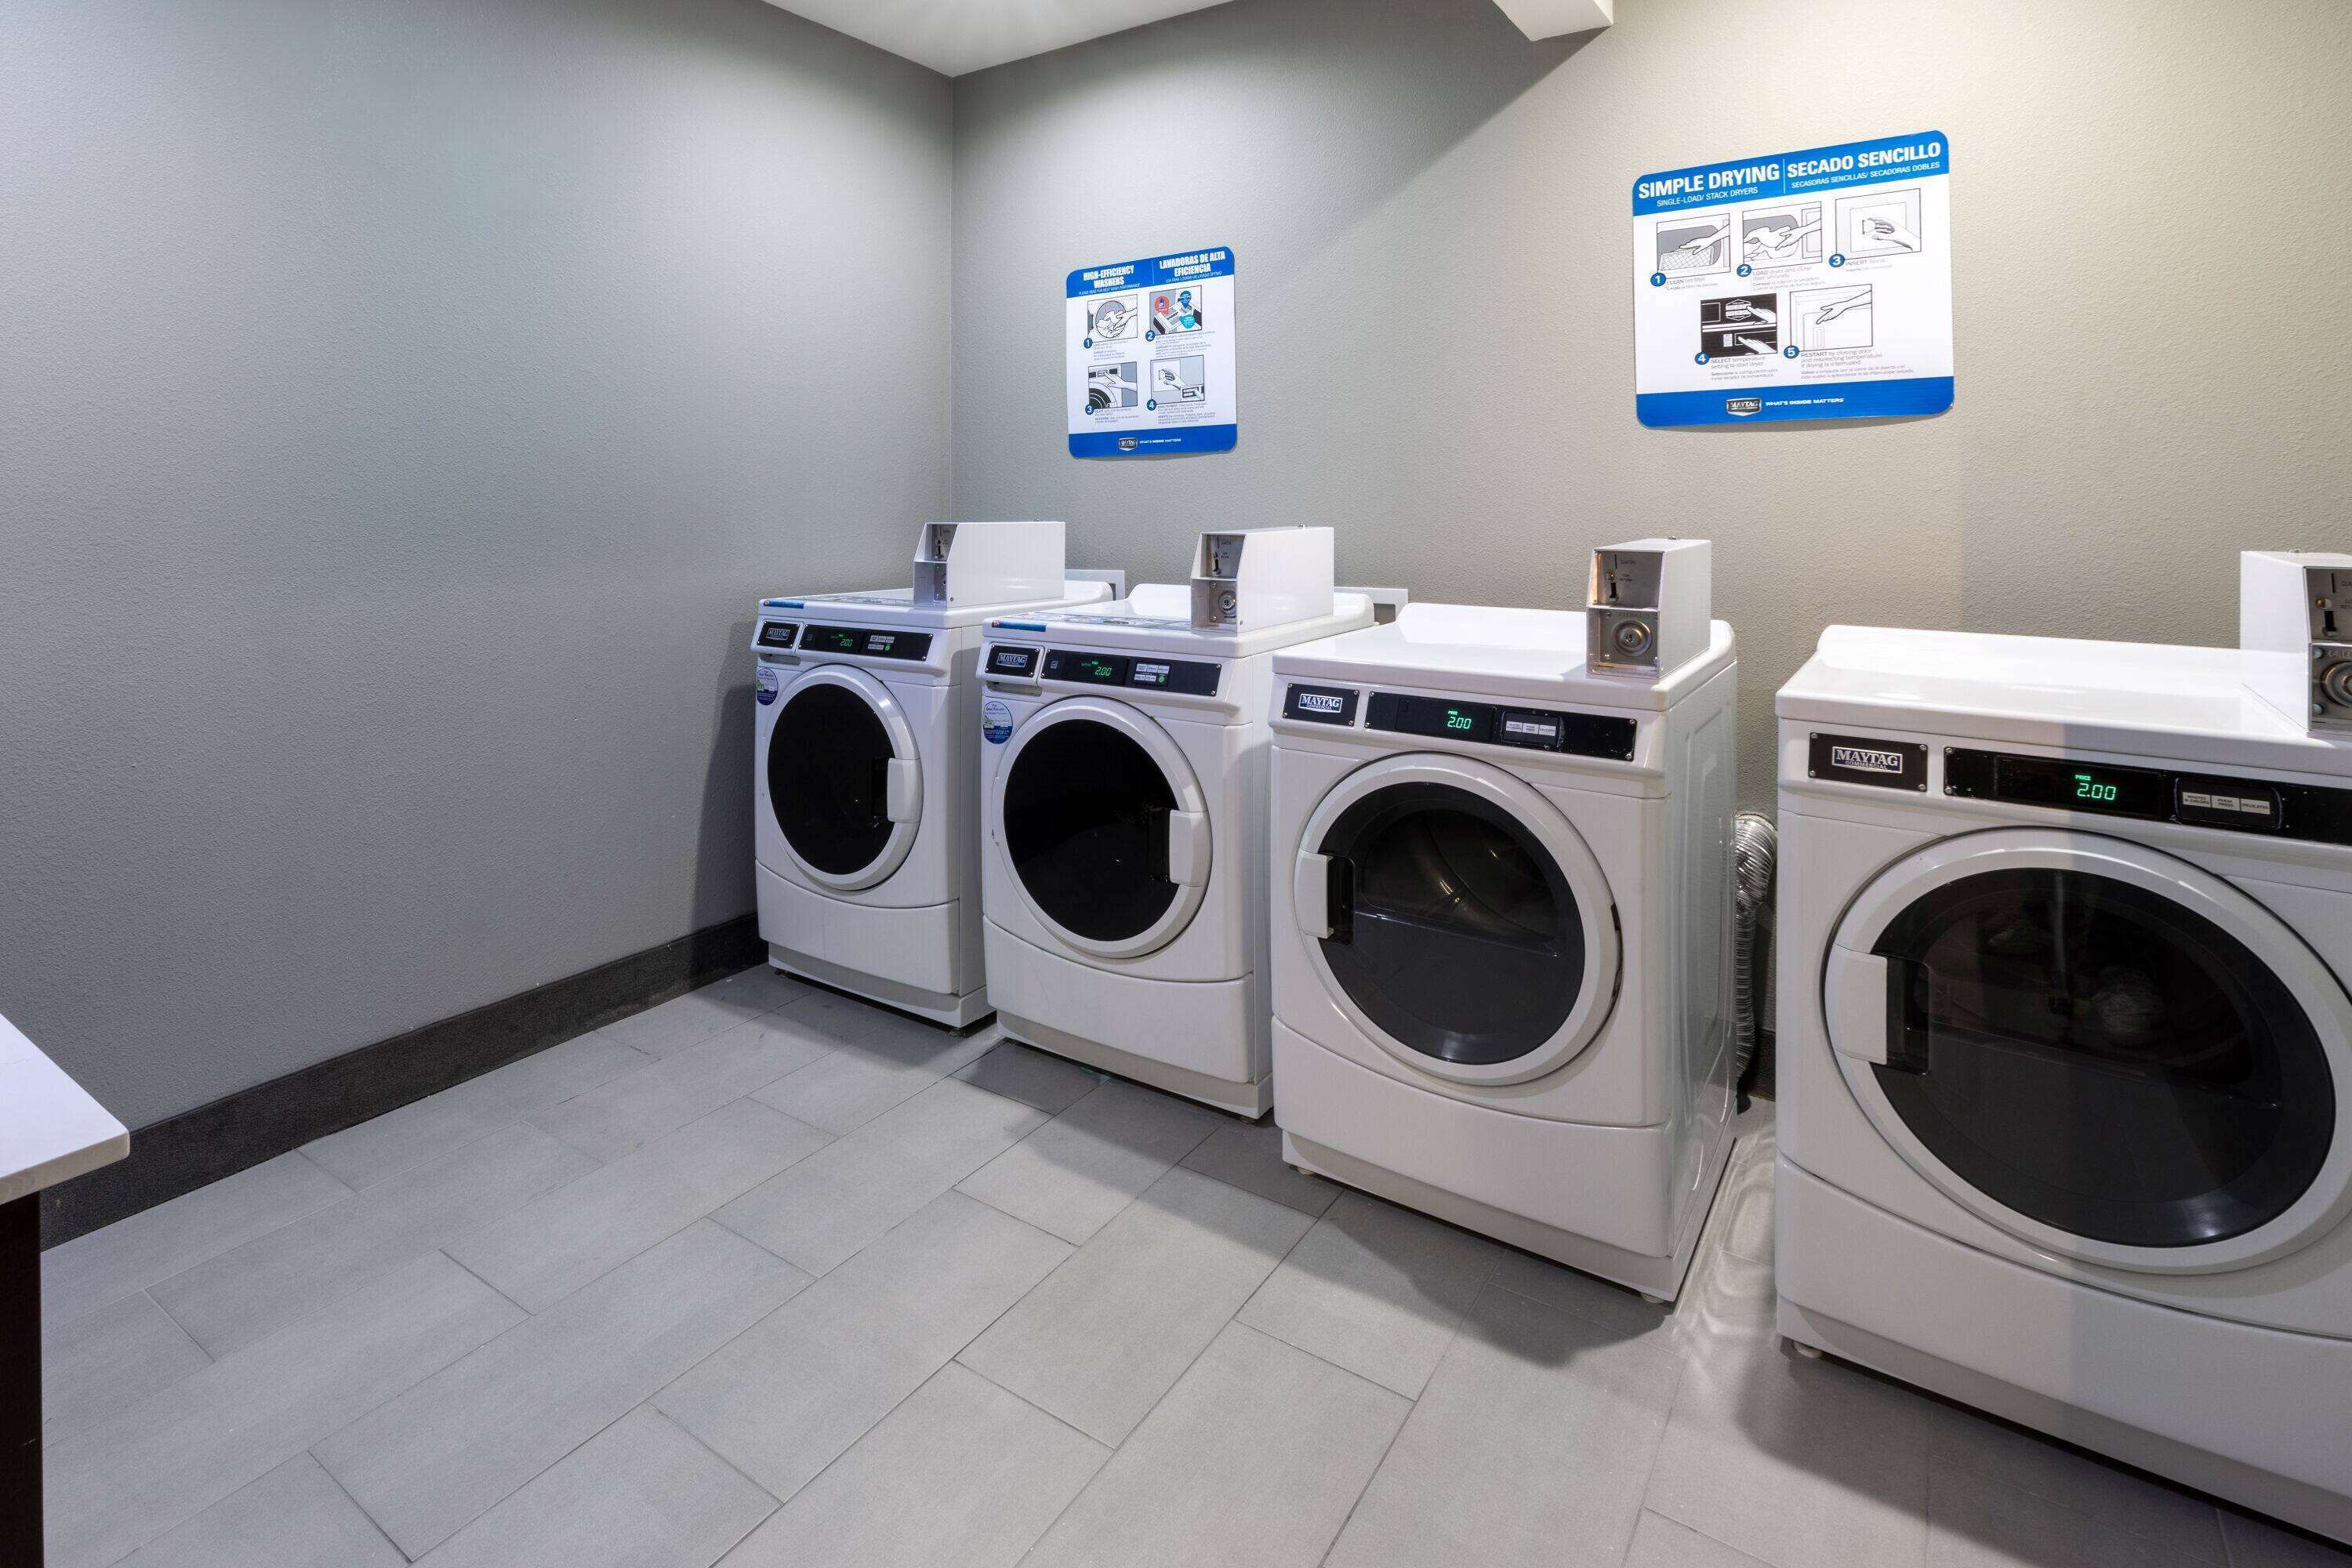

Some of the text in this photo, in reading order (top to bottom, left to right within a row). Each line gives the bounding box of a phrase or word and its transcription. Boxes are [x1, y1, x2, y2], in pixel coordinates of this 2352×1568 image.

[1788, 142, 1941, 178] SECADO SENCILLO
[1871, 166, 1911, 178] SECADORAS
[1912, 162, 1940, 172] DOBLES
[1639, 163, 1780, 199] SIMPLE DRYING
[1657, 187, 1758, 207] SINGLE-LOAD/ STACK DRYERS
[1160, 251, 1225, 269] LAVADORAS DE ALTA
[1833, 256, 1842, 266] 3
[1083, 265, 1134, 281] HIGH-EFFICIENCY
[1174, 263, 1211, 277] EFICIENCIA
[1740, 266, 1748, 275] 2
[1094, 276, 1124, 289] WASHERS
[1654, 275, 1661, 285] 1
[1788, 347, 1795, 357] 5
[1697, 354, 1706, 363] 4
[1000, 655, 1025, 663] MAYTAG
[1095, 666, 1112, 677] 2.00
[1301, 695, 1340, 707] MAYTAG
[1447, 717, 1472, 729] 2.00
[1836, 750, 1898, 767] MAYTAG
[1846, 760, 1887, 770] COMMERCIAL
[2078, 782, 2117, 800] 2.00
